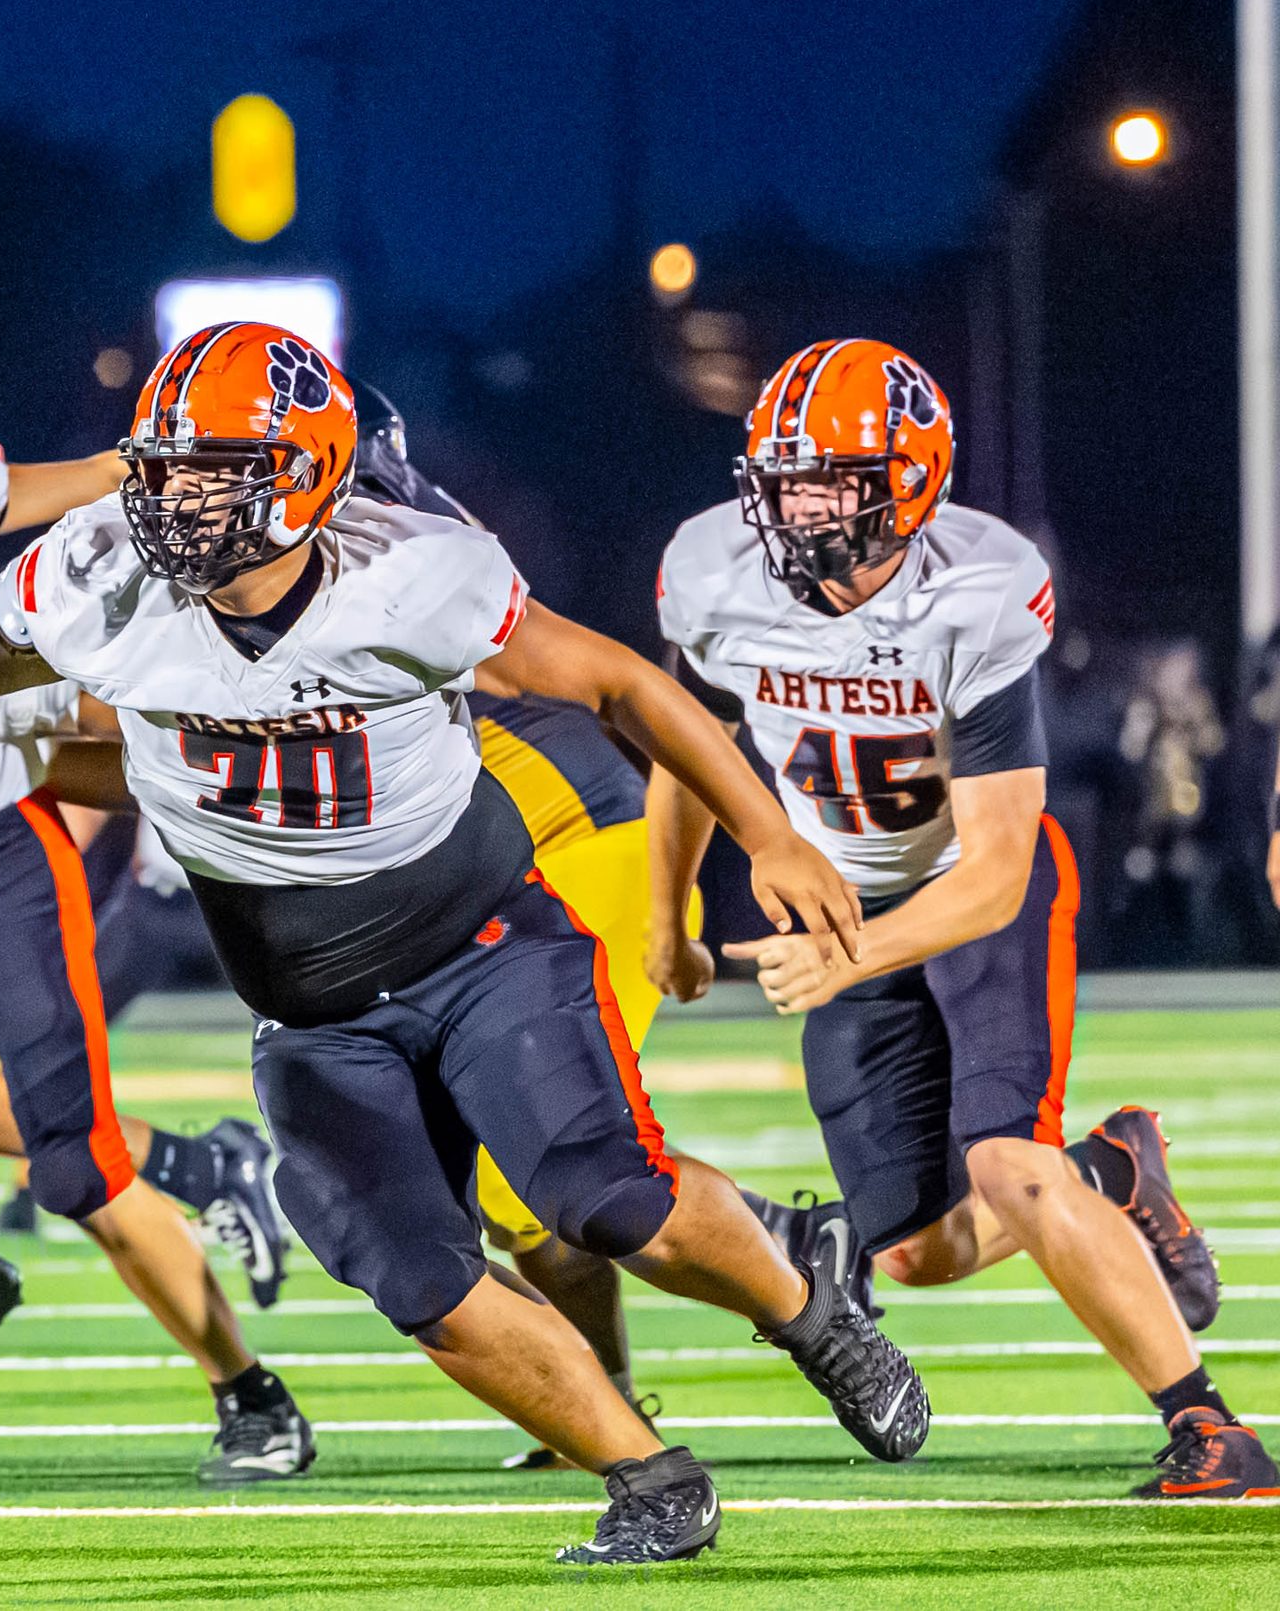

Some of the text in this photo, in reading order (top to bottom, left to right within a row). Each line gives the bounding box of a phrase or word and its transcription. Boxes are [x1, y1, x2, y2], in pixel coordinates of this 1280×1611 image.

[756, 666, 938, 717] ARTESIA
[179, 728, 372, 829] 70
[782, 727, 948, 835] 45
